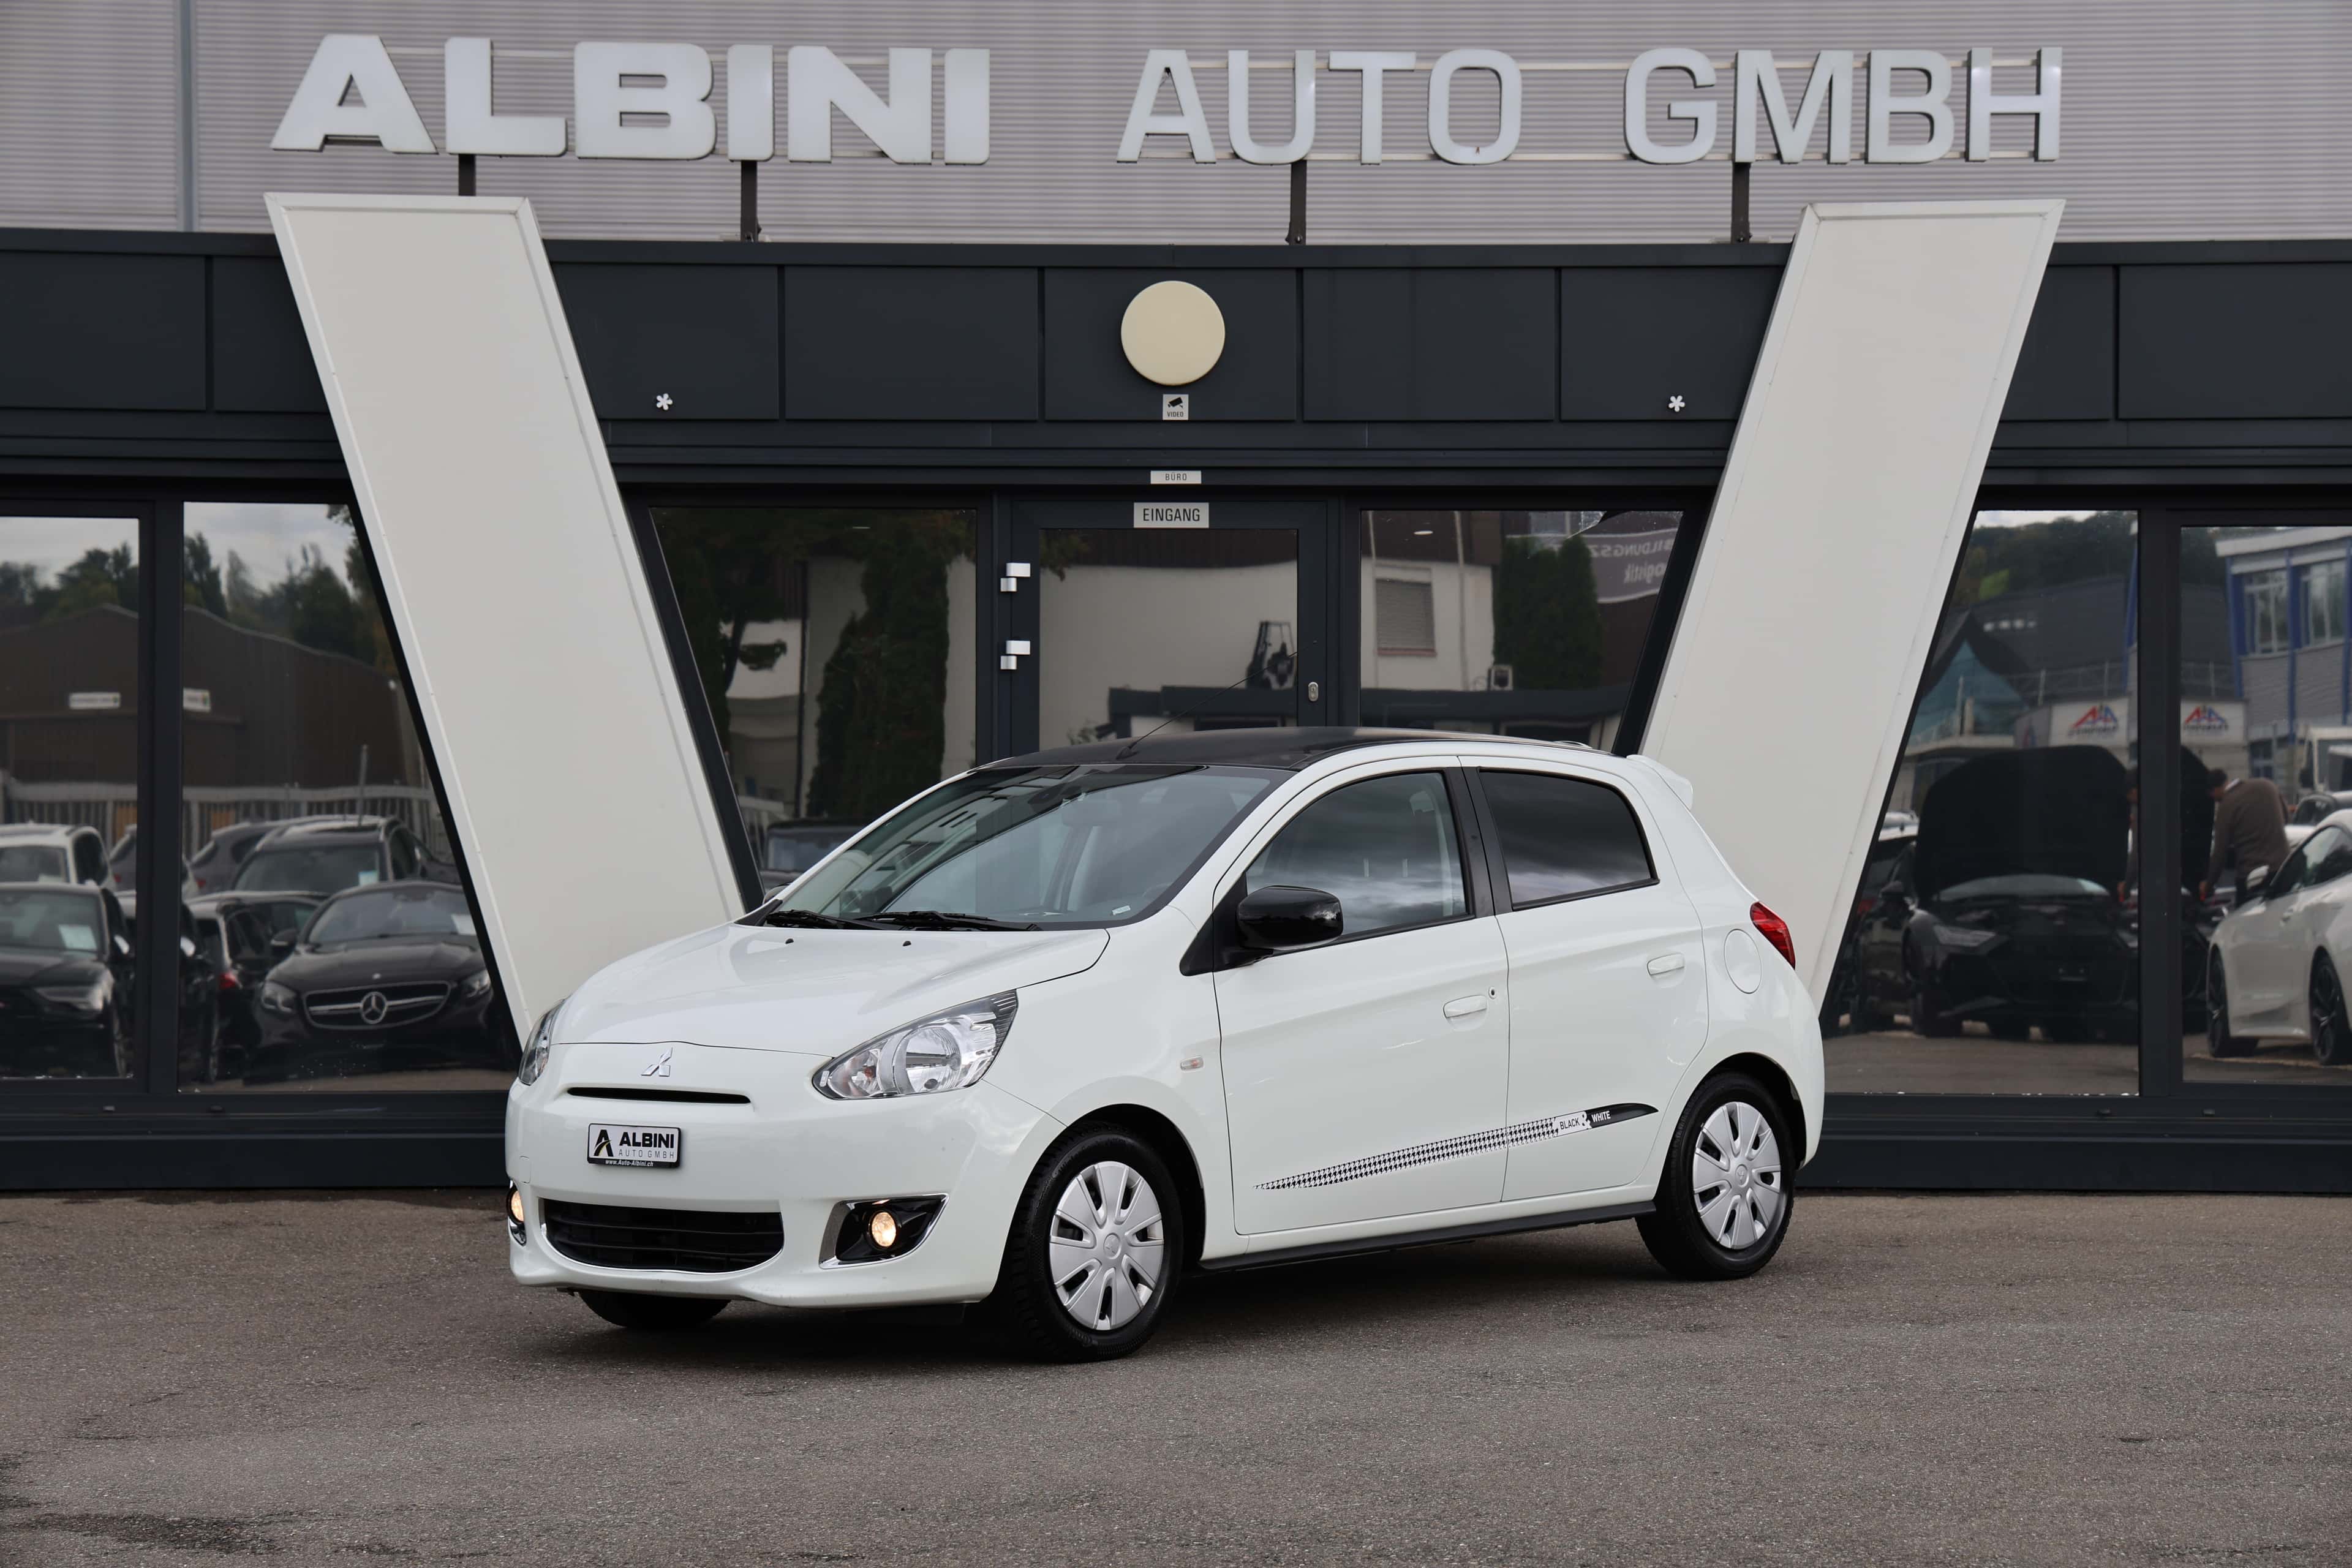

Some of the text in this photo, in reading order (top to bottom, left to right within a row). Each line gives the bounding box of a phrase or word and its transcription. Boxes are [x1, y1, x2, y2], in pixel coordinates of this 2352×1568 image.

[270, 34, 2063, 165] ALBINI AUTO GMBH
[1143, 508, 1200, 522] EINGANG
[1559, 1117, 1580, 1130] BLACK
[1591, 1110, 1611, 1123] WHITE
[619, 1131, 674, 1148] ALBINI
[618, 1148, 674, 1159] AUTO GMBH
